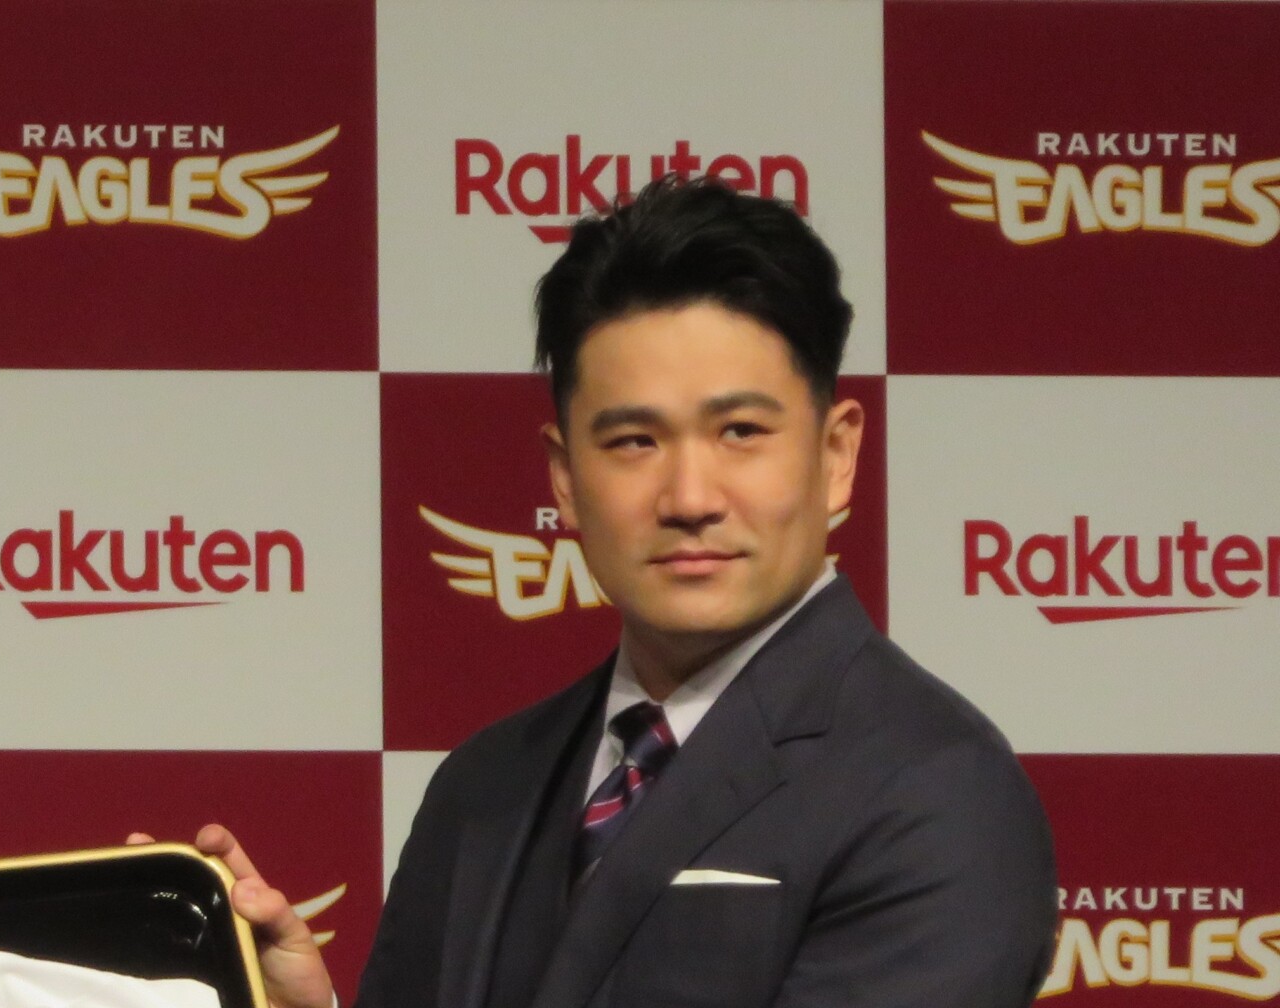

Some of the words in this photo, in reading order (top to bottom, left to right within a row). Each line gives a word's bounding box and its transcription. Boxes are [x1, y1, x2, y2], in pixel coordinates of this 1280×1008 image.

[22, 124, 226, 149] RAKUTEN
[1037, 132, 1237, 157] RAKUTEN
[992, 158, 1280, 247] EAGLES
